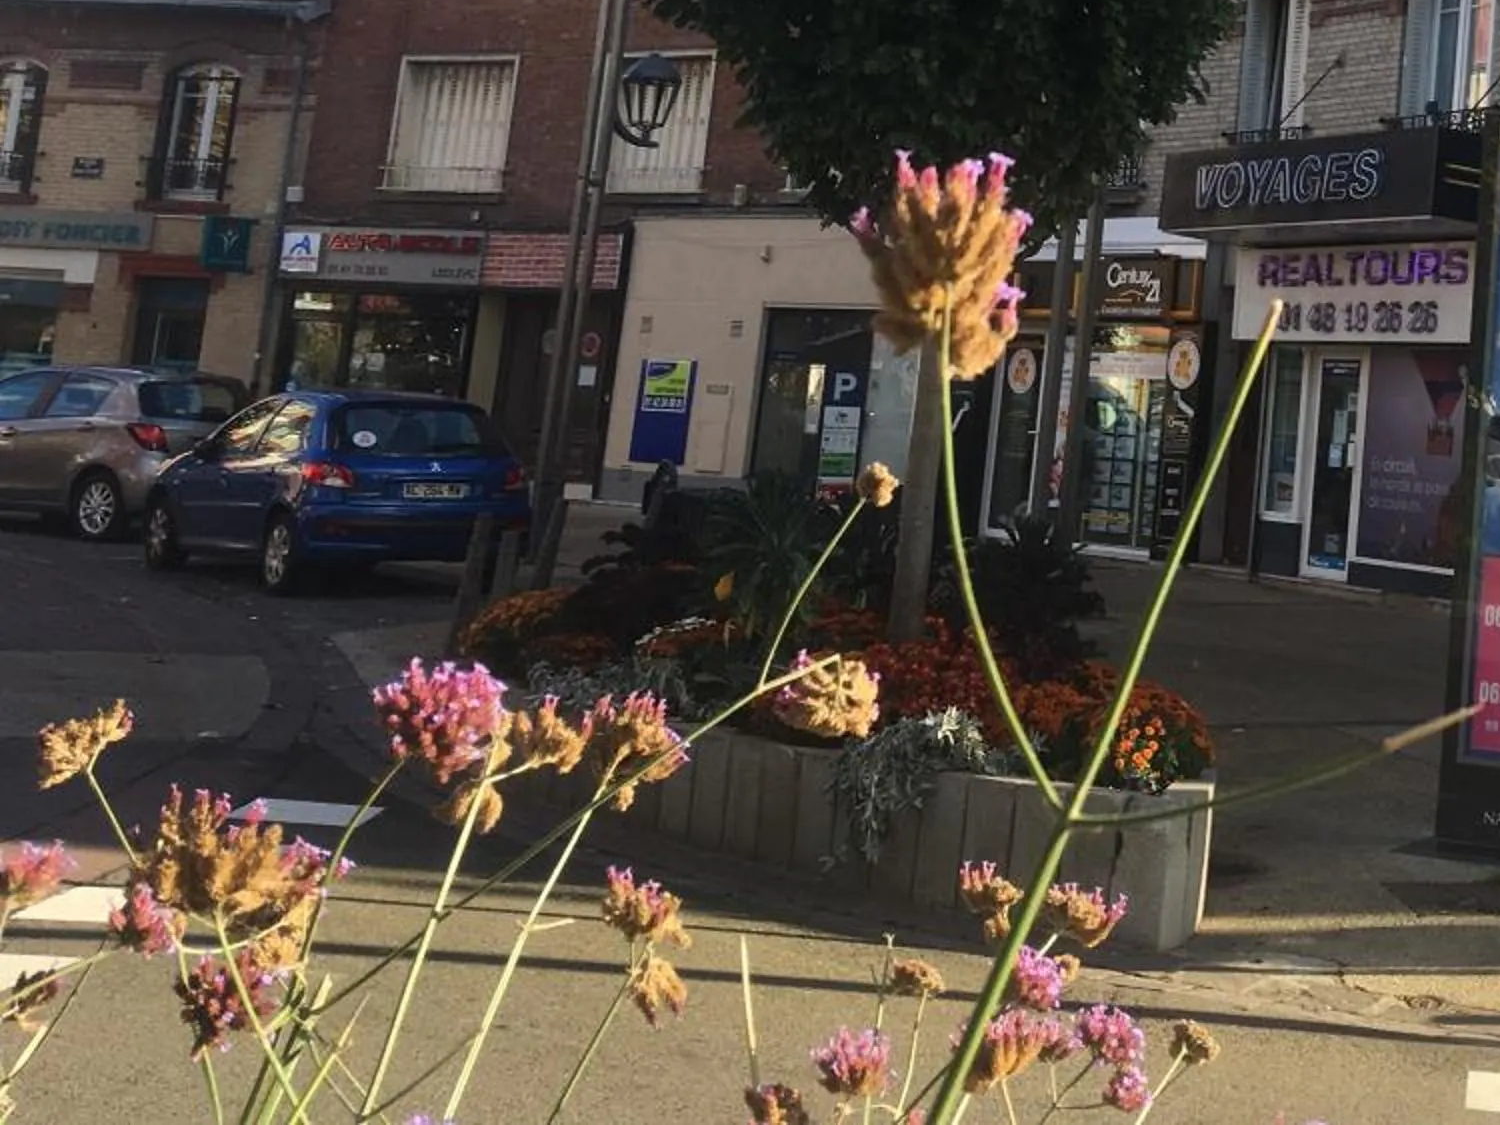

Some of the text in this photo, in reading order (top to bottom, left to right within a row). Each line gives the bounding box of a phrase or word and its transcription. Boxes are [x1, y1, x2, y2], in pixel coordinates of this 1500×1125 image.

[1195, 148, 1381, 210] VOYAGES
[1107, 262, 1161, 303] Century 21
[1373, 300, 1403, 334] 26
[1407, 300, 1439, 334] 26
[833, 372, 857, 401] P
